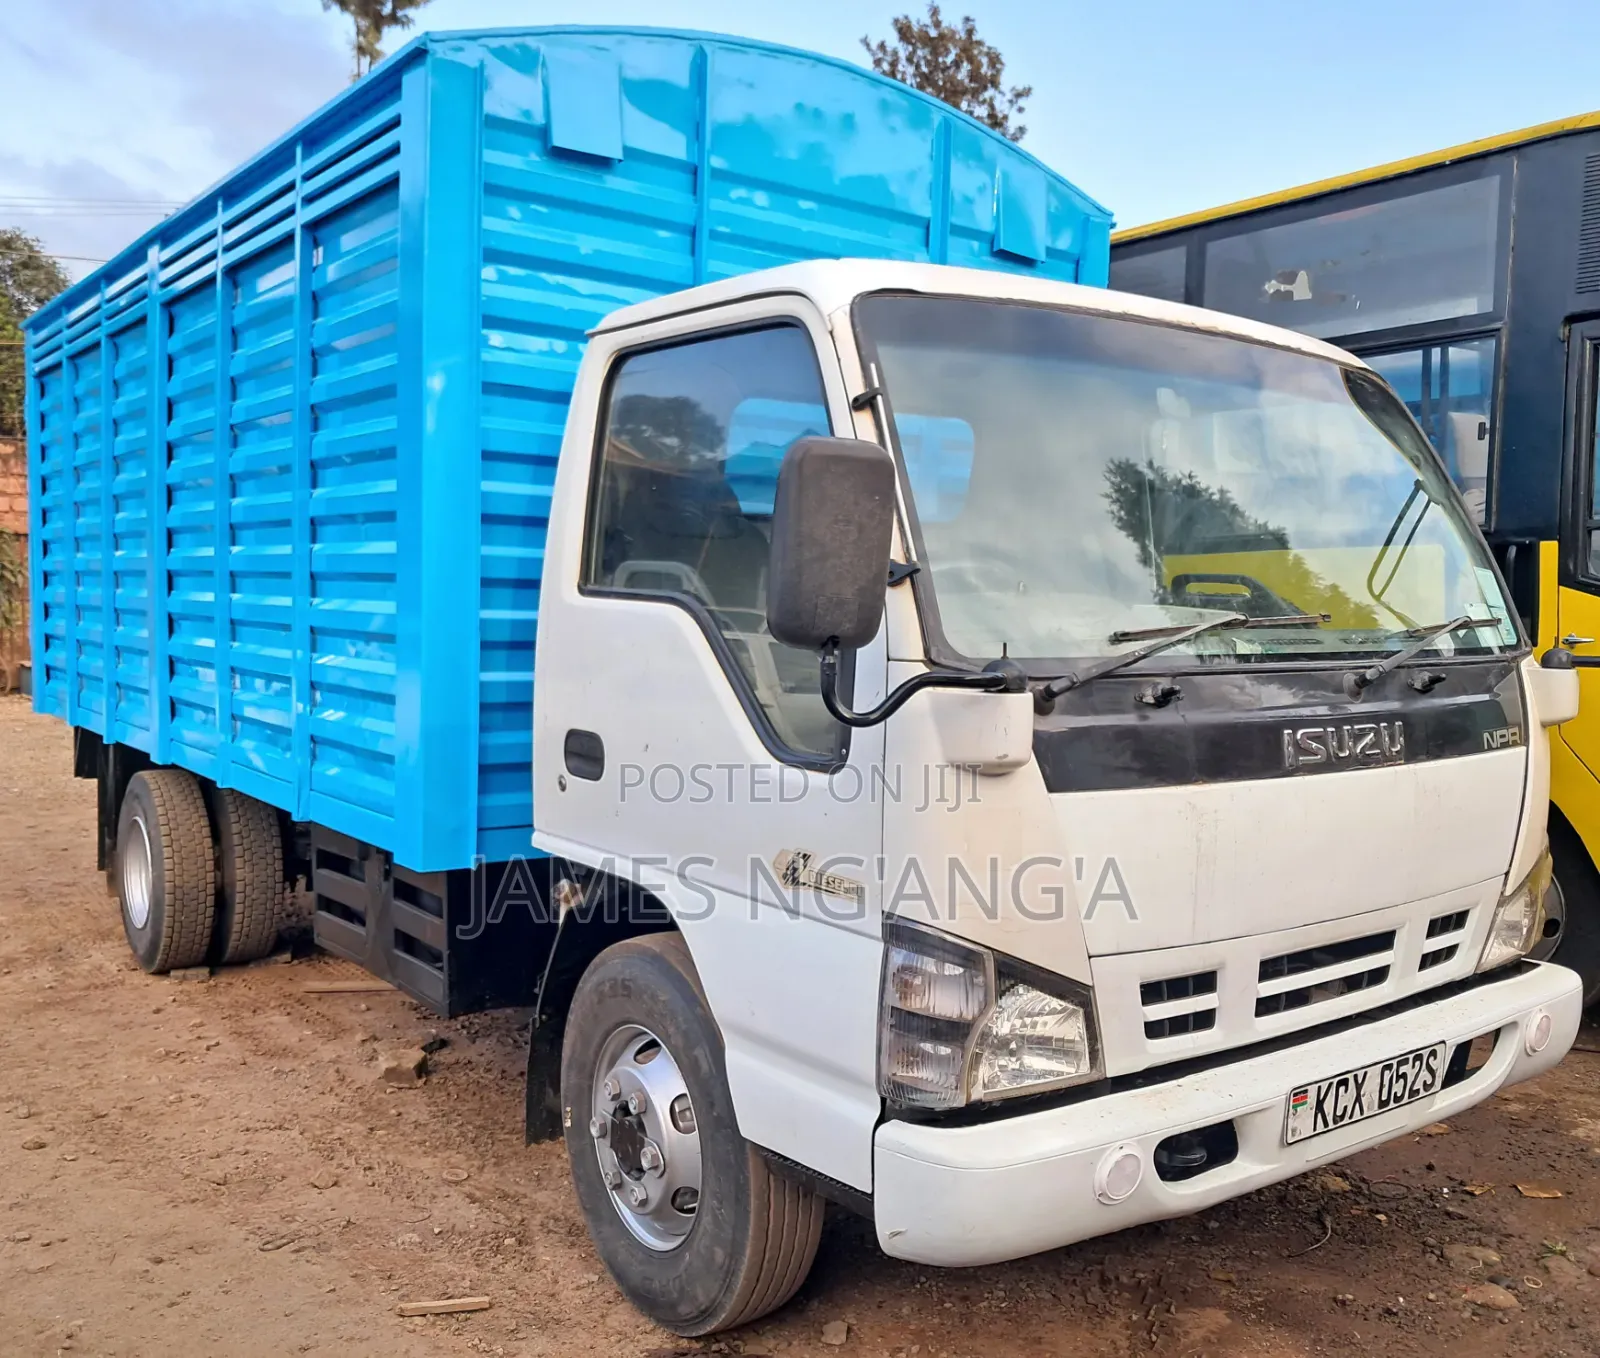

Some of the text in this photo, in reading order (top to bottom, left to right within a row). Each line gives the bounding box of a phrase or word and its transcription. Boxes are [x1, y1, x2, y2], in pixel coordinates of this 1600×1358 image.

[1282, 721, 1405, 770] ISUZU
[1483, 726, 1521, 750] NPR
[808, 869, 849, 894] DIESEL
[1313, 1048, 1438, 1132] KCX 052S
